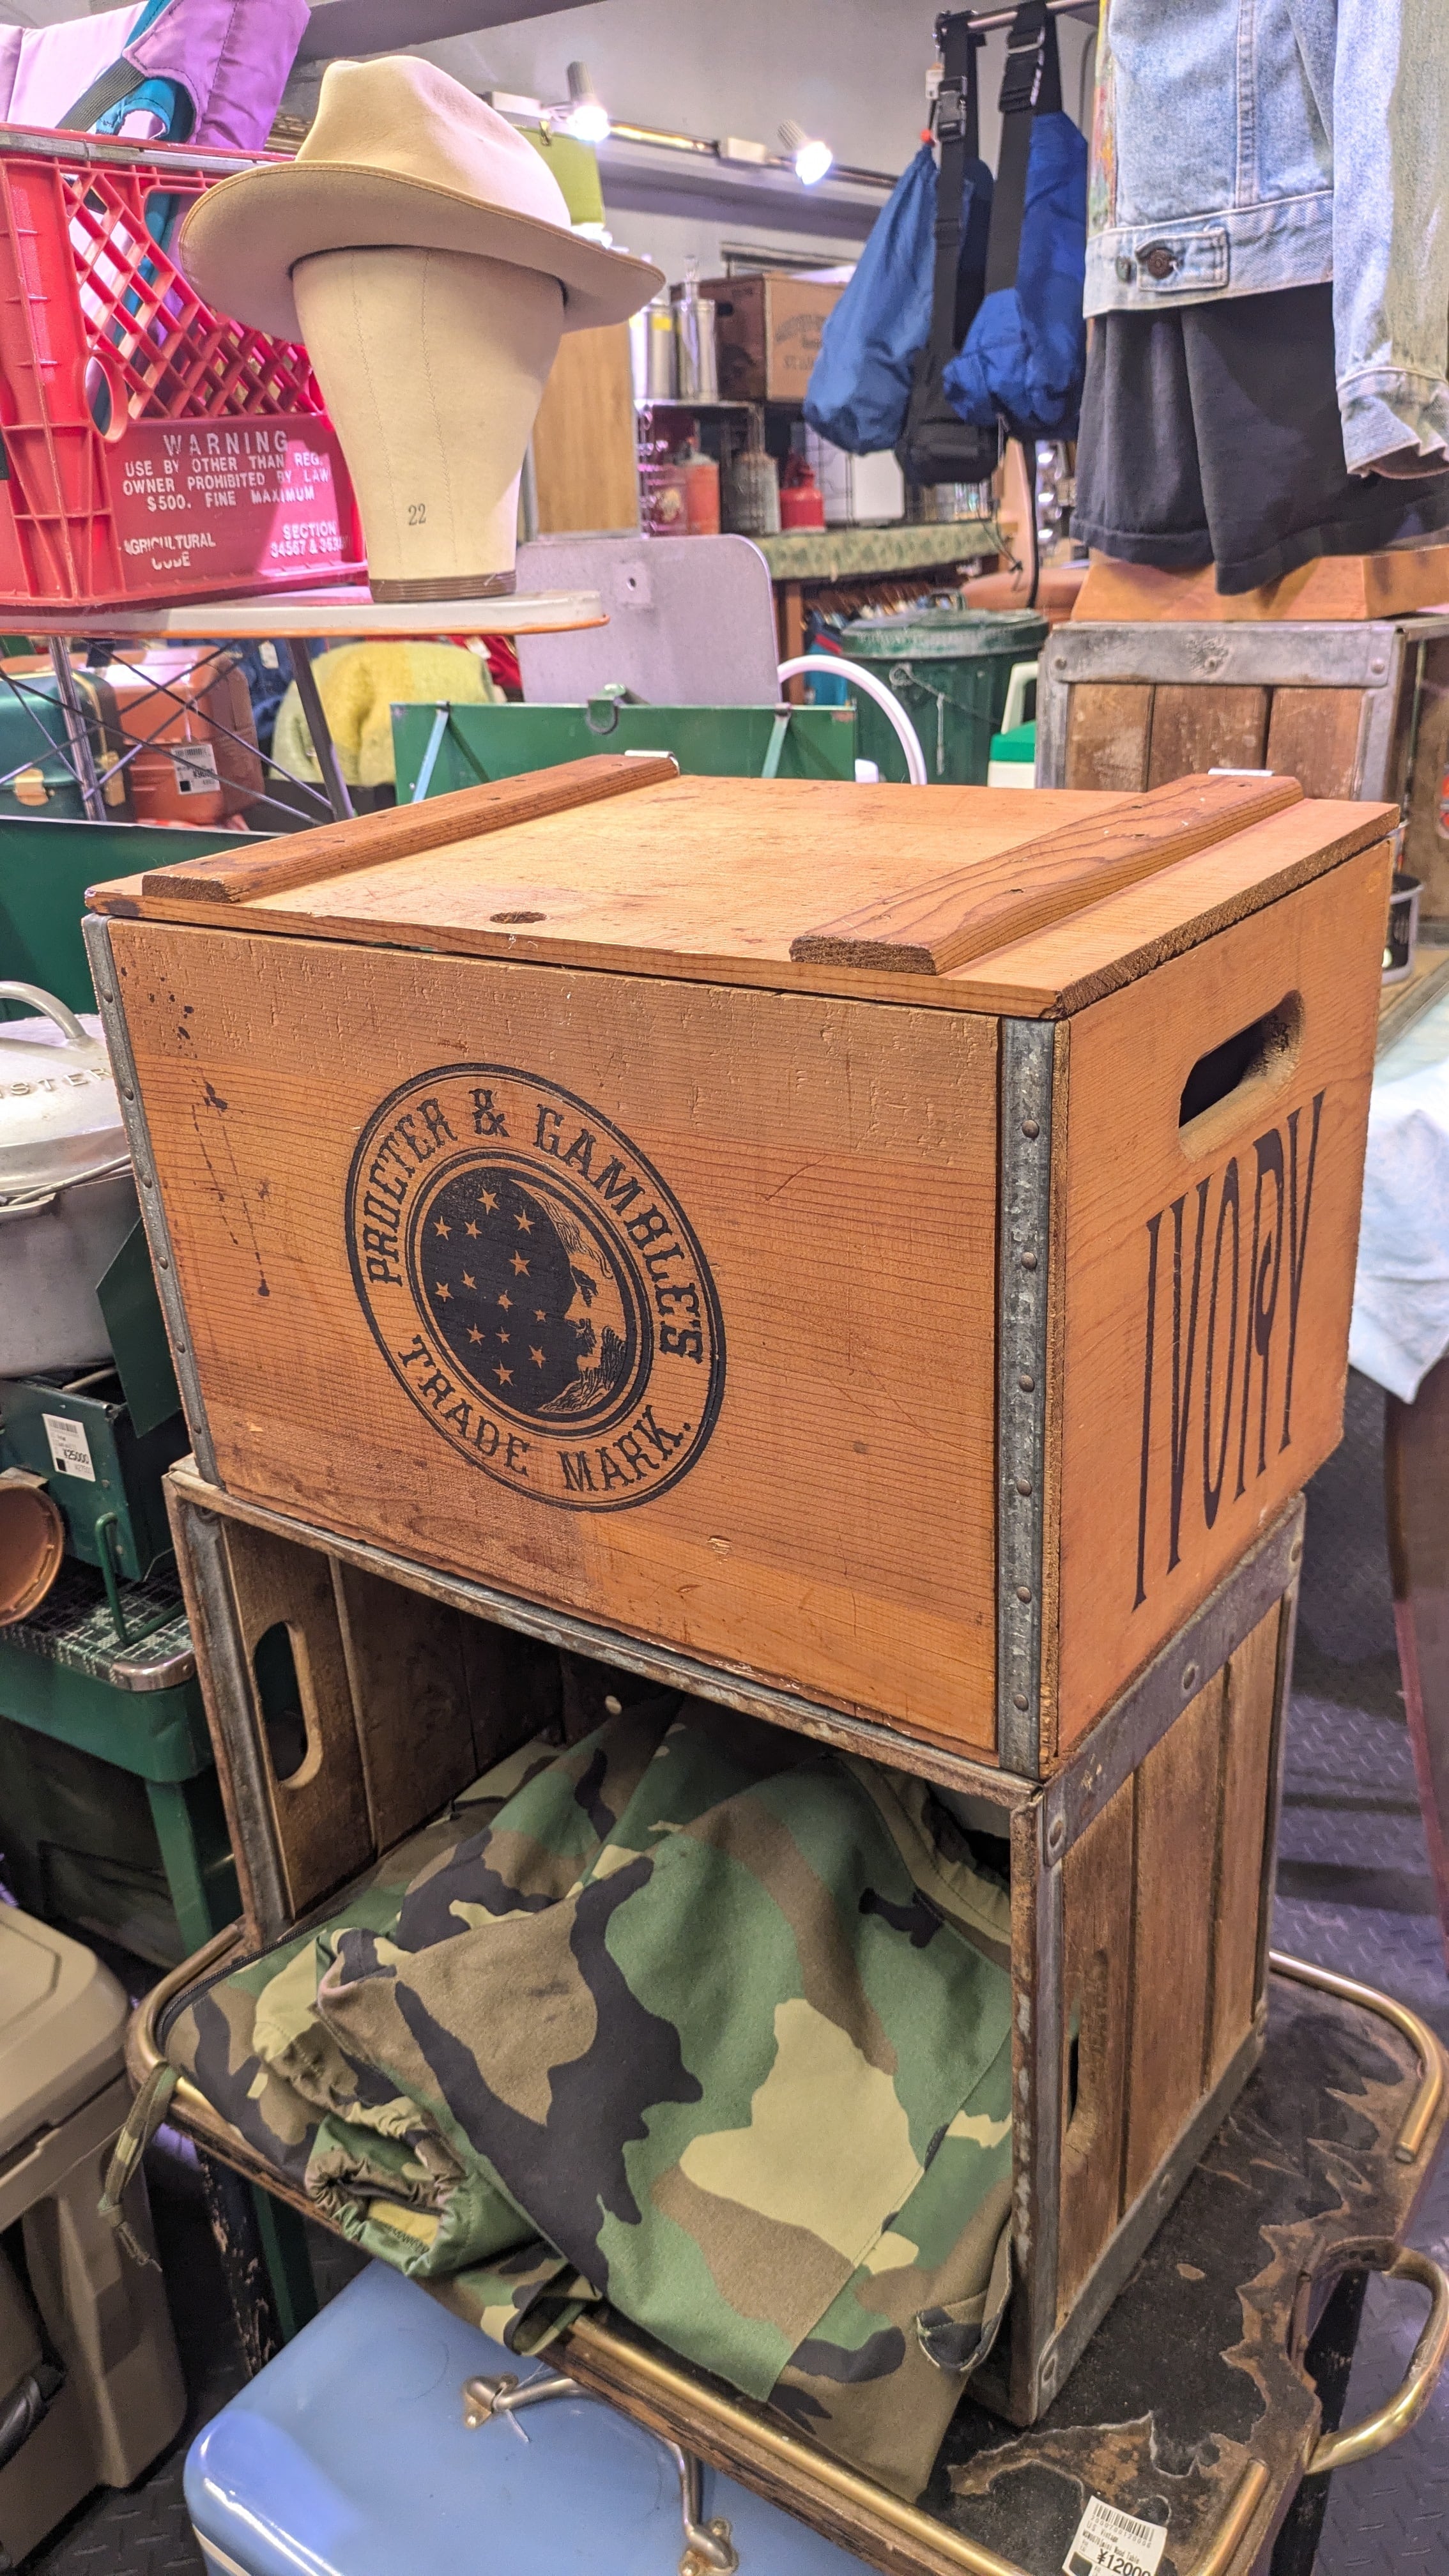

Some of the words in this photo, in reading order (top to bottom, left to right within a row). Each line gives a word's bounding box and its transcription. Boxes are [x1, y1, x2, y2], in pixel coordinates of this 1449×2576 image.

[164, 431, 287, 456] WARNING
[125, 460, 153, 477] USE
[164, 459, 179, 474] BY
[192, 457, 238, 473] OTHER
[249, 454, 284, 470] THAN
[123, 478, 175, 496] OWNER
[187, 471, 265, 491] PROHIBITED
[277, 470, 292, 484] BY
[303, 468, 328, 483] LAW
[147, 494, 192, 512] $500.
[205, 490, 236, 508] FINE
[250, 486, 314, 505] MAXIMUM
[408, 503, 426, 525] 22
[282, 521, 337, 540] SECTION
[0, 1068, 111, 1099] STER
[363, 1098, 458, 1288] PROCTER
[468, 1088, 510, 1138] &
[1131, 1088, 1326, 1612] IVORY
[398, 1334, 532, 1477] TRADE
[556, 1406, 693, 1492] MARK.
